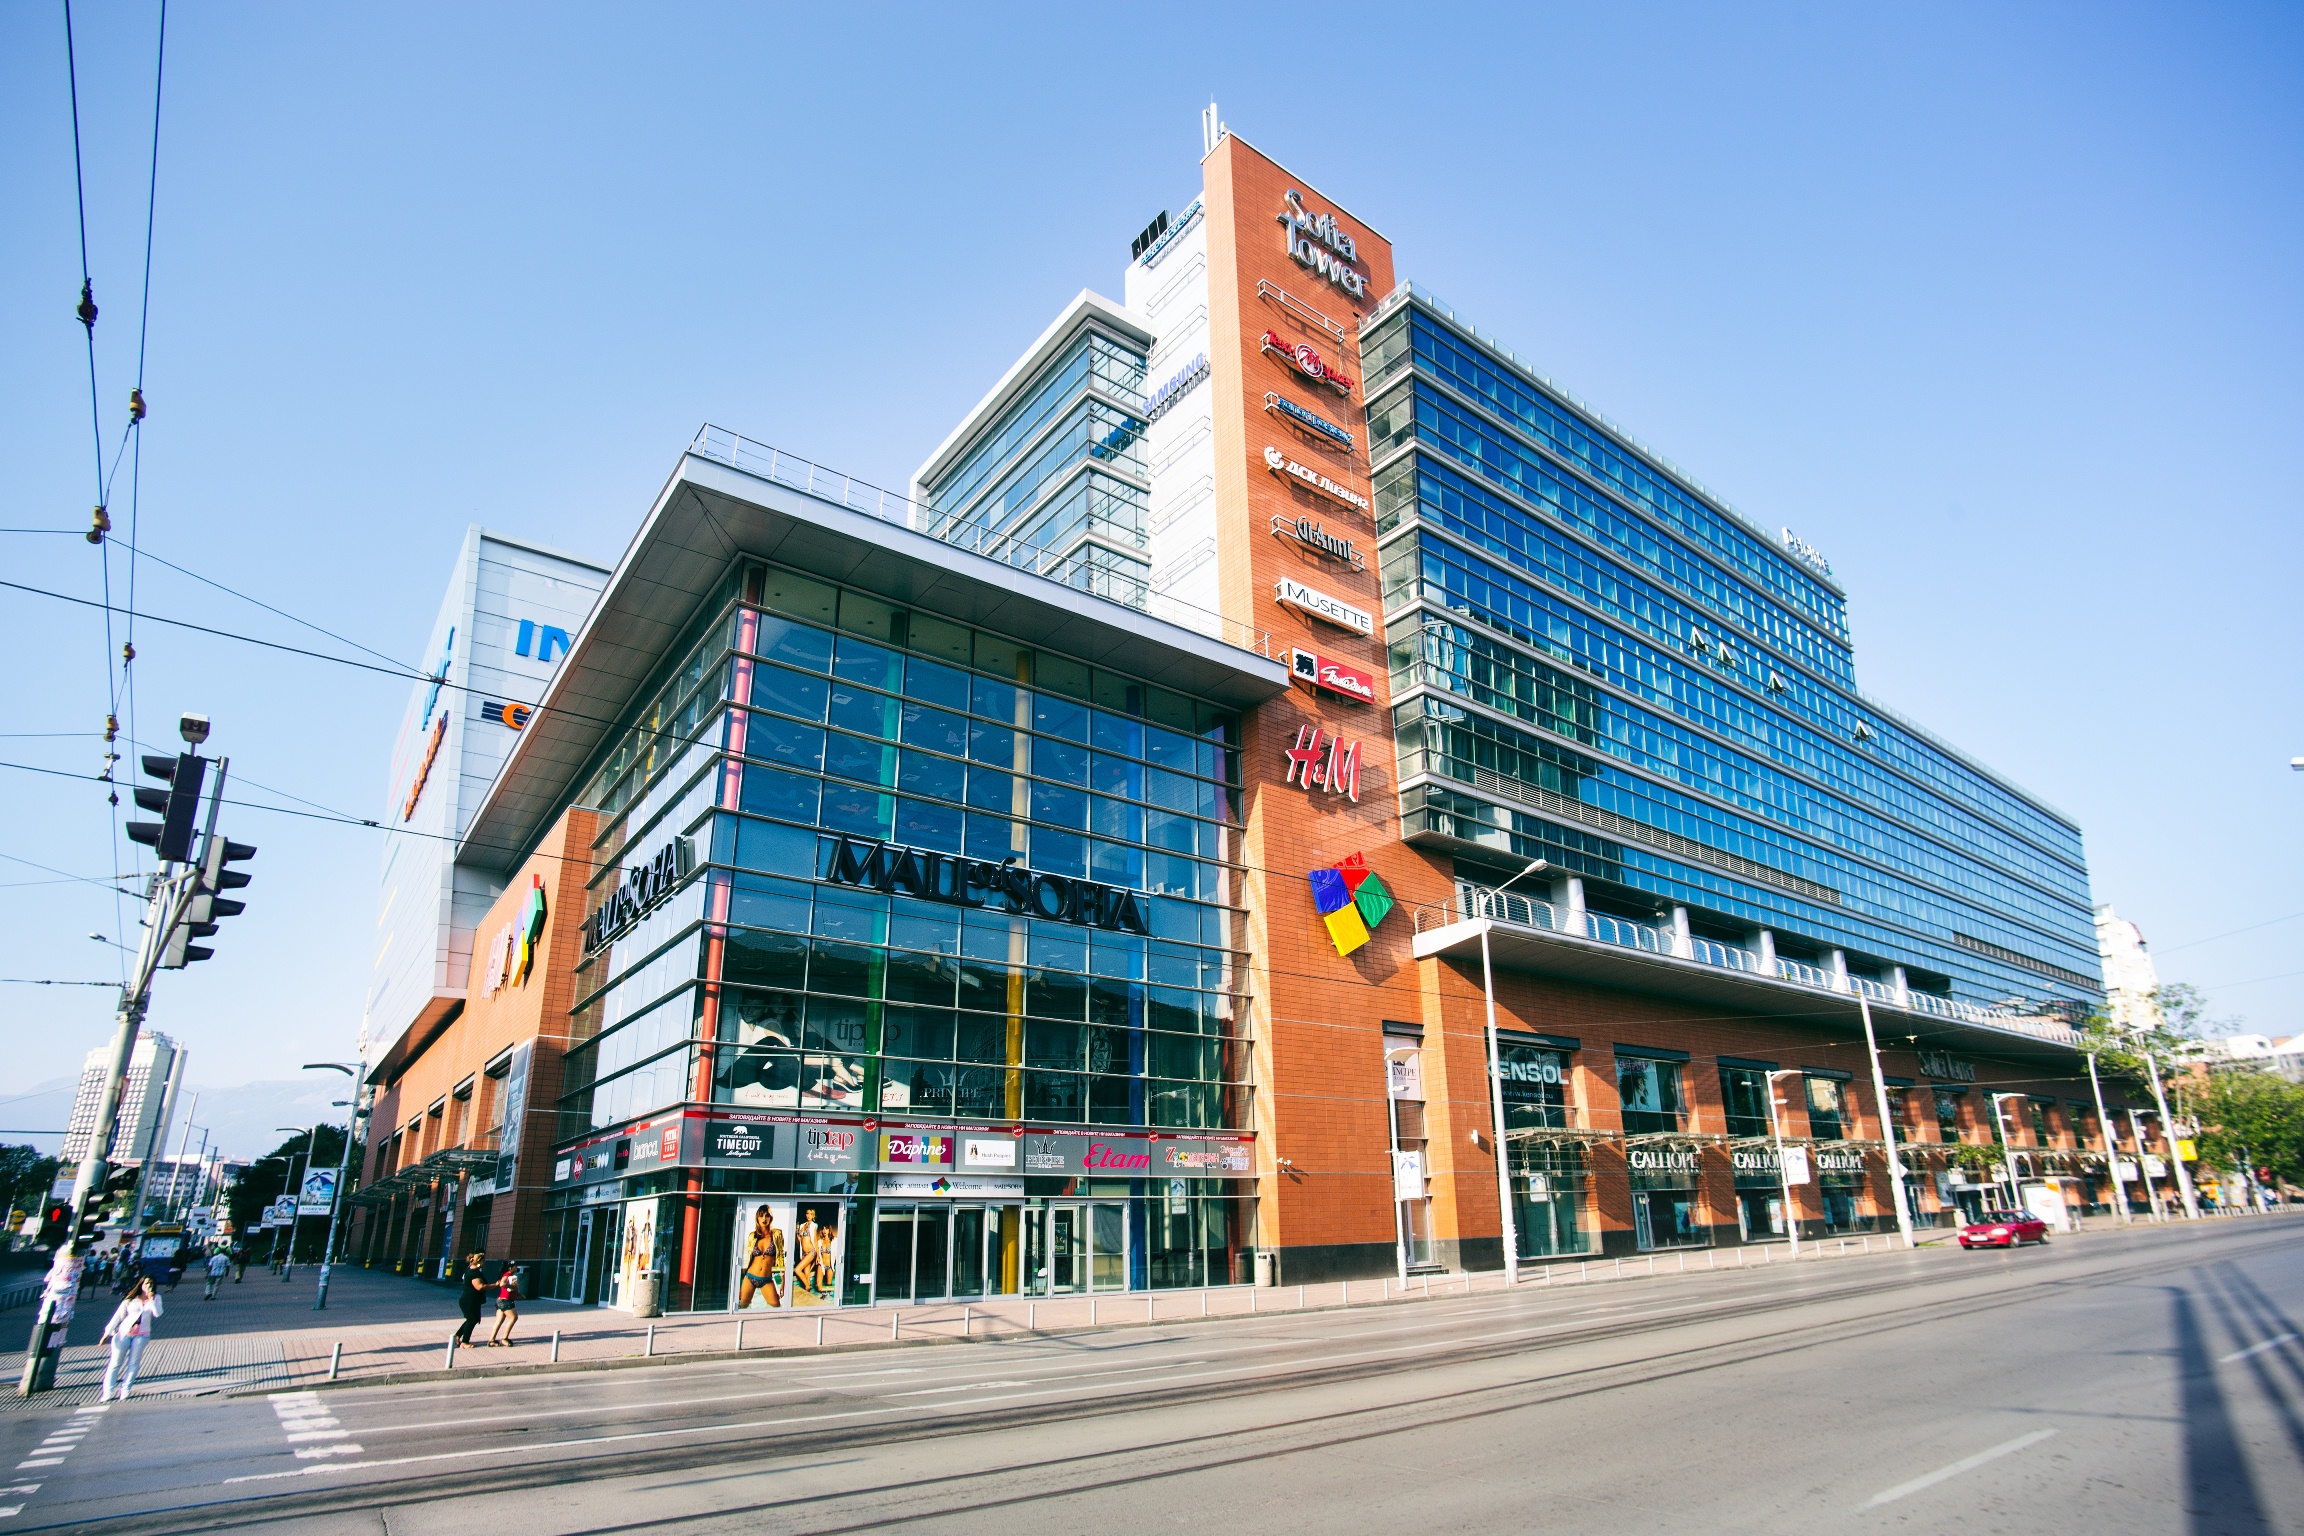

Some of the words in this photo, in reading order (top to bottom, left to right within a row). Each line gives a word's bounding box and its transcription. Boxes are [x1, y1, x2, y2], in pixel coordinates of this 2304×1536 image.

[1284, 188, 1357, 264] Sofia
[1276, 210, 1368, 300] Tower
[1142, 352, 1206, 418] SAMSUNG
[1286, 461, 1319, 485] ДСК
[1287, 582, 1370, 630] MUSETTE
[1286, 724, 1363, 803] H&M
[827, 833, 986, 907] MALL
[1001, 867, 1151, 935] SOFIA
[717, 1138, 762, 1151] TIMEOUT
[806, 1127, 854, 1150] tiptap
[1083, 1143, 1150, 1169] Etam
[1631, 1151, 1699, 1169] CALLIOPE
[952, 1181, 982, 1189] Welcome
